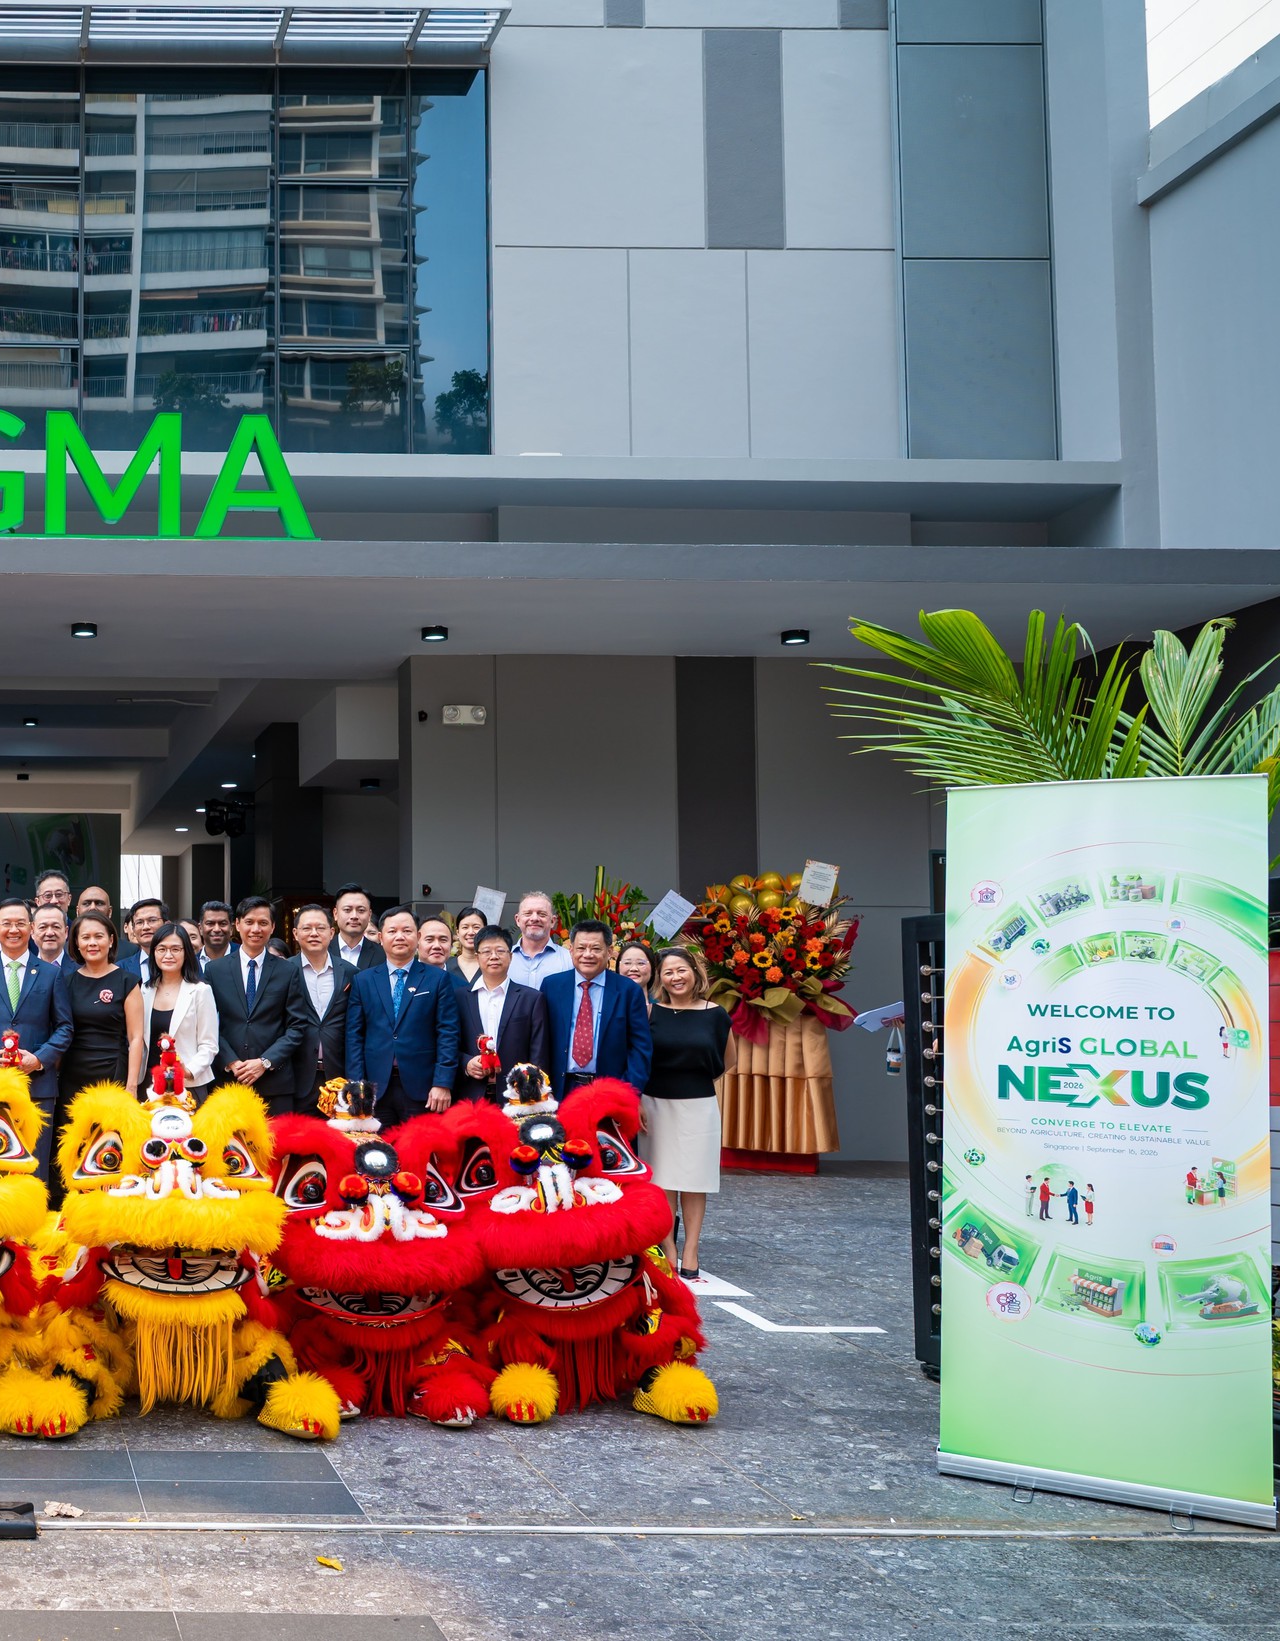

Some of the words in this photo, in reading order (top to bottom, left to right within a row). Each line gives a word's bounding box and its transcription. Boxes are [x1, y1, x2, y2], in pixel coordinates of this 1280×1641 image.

[1027, 1003, 1139, 1020] WELCOME
[1144, 1006, 1175, 1021] TO
[1006, 1035, 1072, 1058] AgriS
[1079, 1037, 1198, 1060] GLOBAL
[998, 1063, 1210, 1111] NEXUS
[1063, 1081, 1084, 1090] 2026
[1031, 1117, 1096, 1128] CONVERGE
[1100, 1121, 1115, 1130] TO
[1119, 1122, 1172, 1133] ELEVATE
[996, 1126, 1027, 1134] BEYOND
[1030, 1129, 1085, 1138] AGRICULTURE,
[1087, 1132, 1126, 1141] CREATING
[1129, 1135, 1182, 1144] SUSTAINABLE
[1043, 1142, 1079, 1151] Singapore
[1086, 1145, 1125, 1154] September
[1084, 1272, 1103, 1282] AgriS
